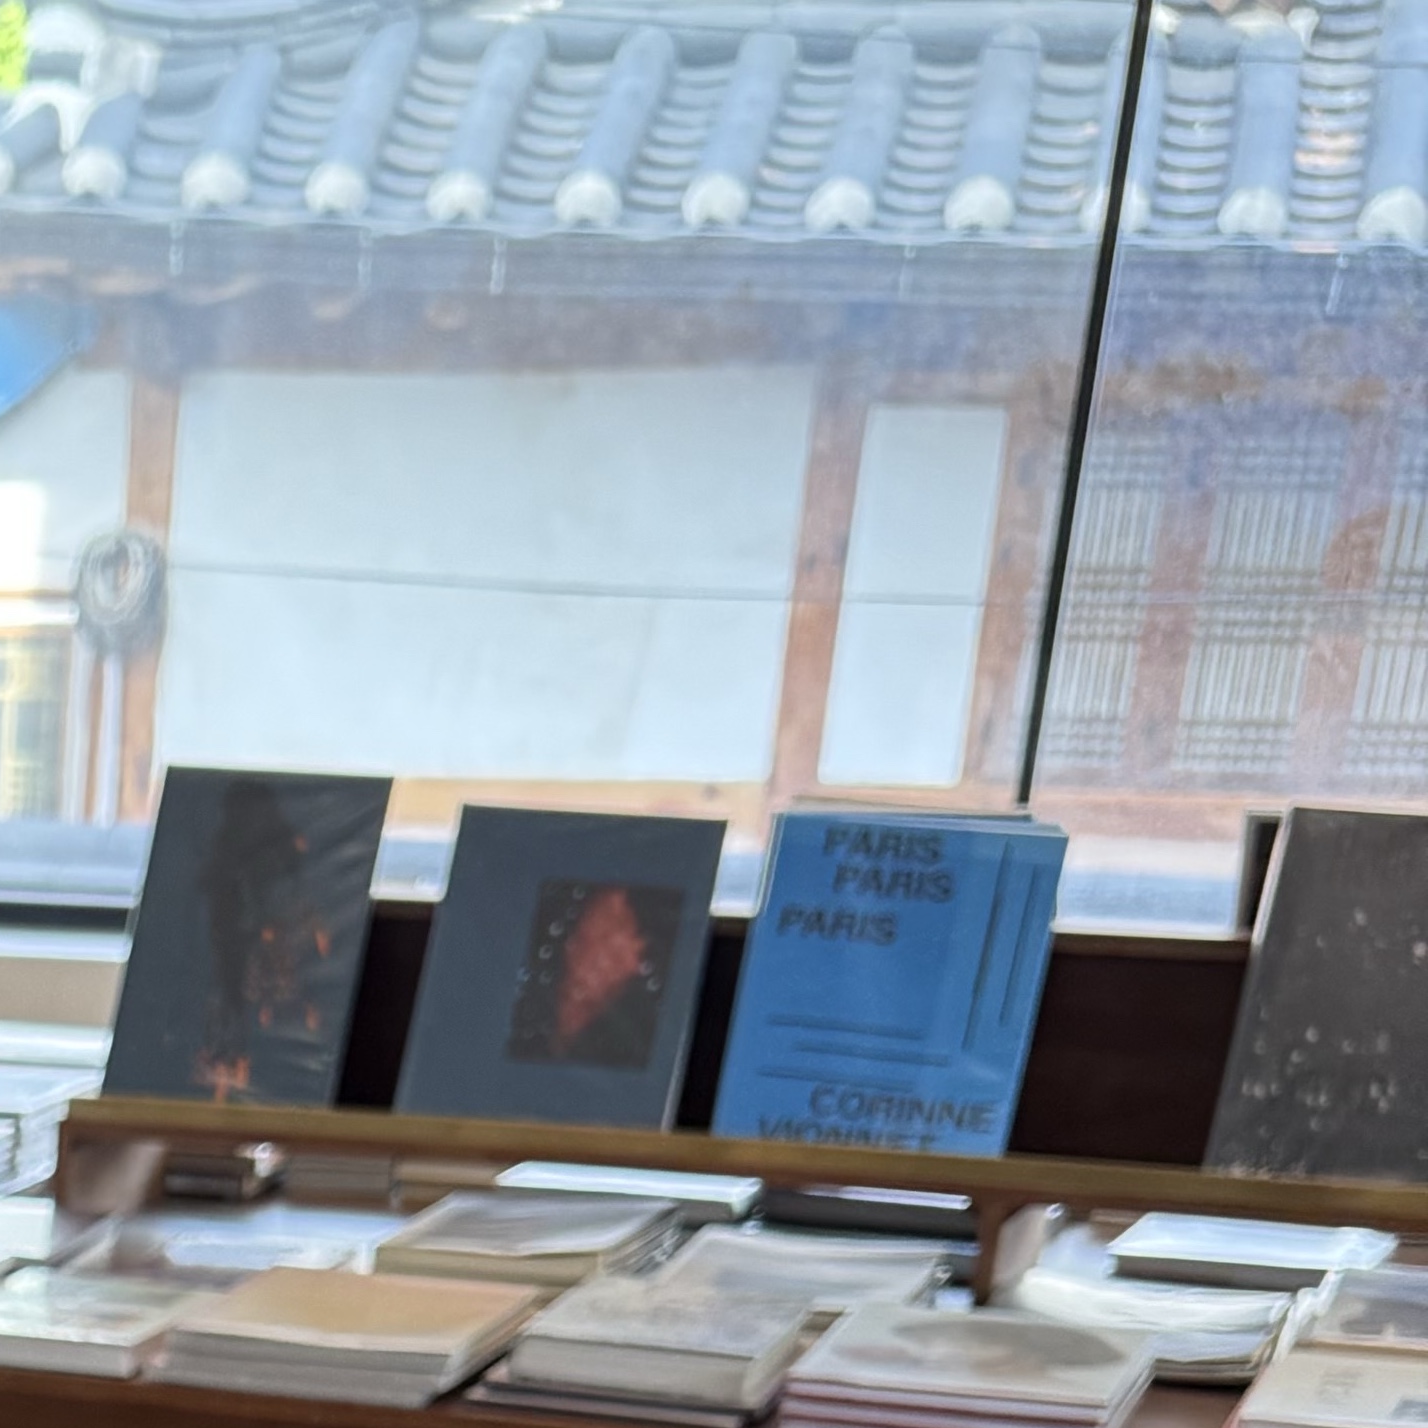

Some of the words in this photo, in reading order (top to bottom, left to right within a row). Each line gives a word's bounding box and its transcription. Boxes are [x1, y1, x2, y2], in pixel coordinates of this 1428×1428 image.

[823, 824, 944, 864] PARIS
[832, 863, 956, 904] PARIS
[777, 903, 899, 946] PARIS
[810, 1083, 996, 1134] CORINNE
